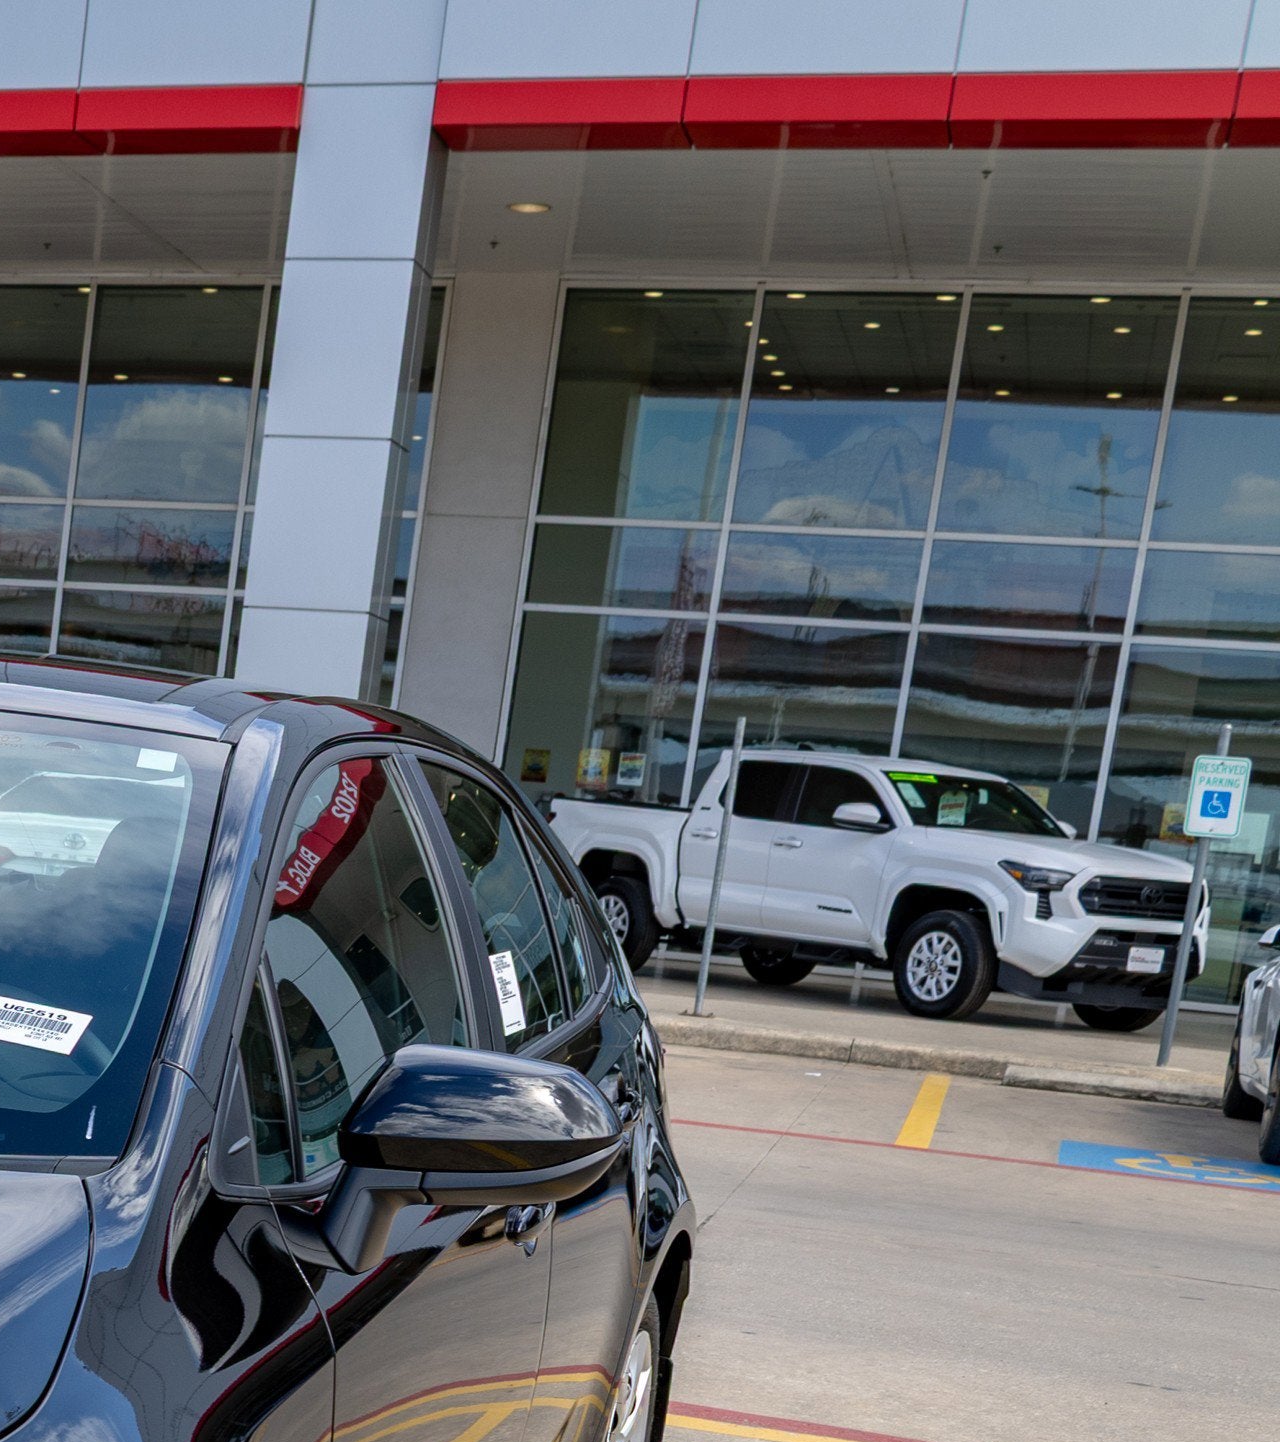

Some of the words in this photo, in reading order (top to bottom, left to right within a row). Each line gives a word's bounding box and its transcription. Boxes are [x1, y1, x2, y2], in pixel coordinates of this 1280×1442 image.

[1198, 762, 1247, 775] RESERVED
[1198, 776, 1240, 789] PARKING
[2, 1002, 68, 1021] U62519
